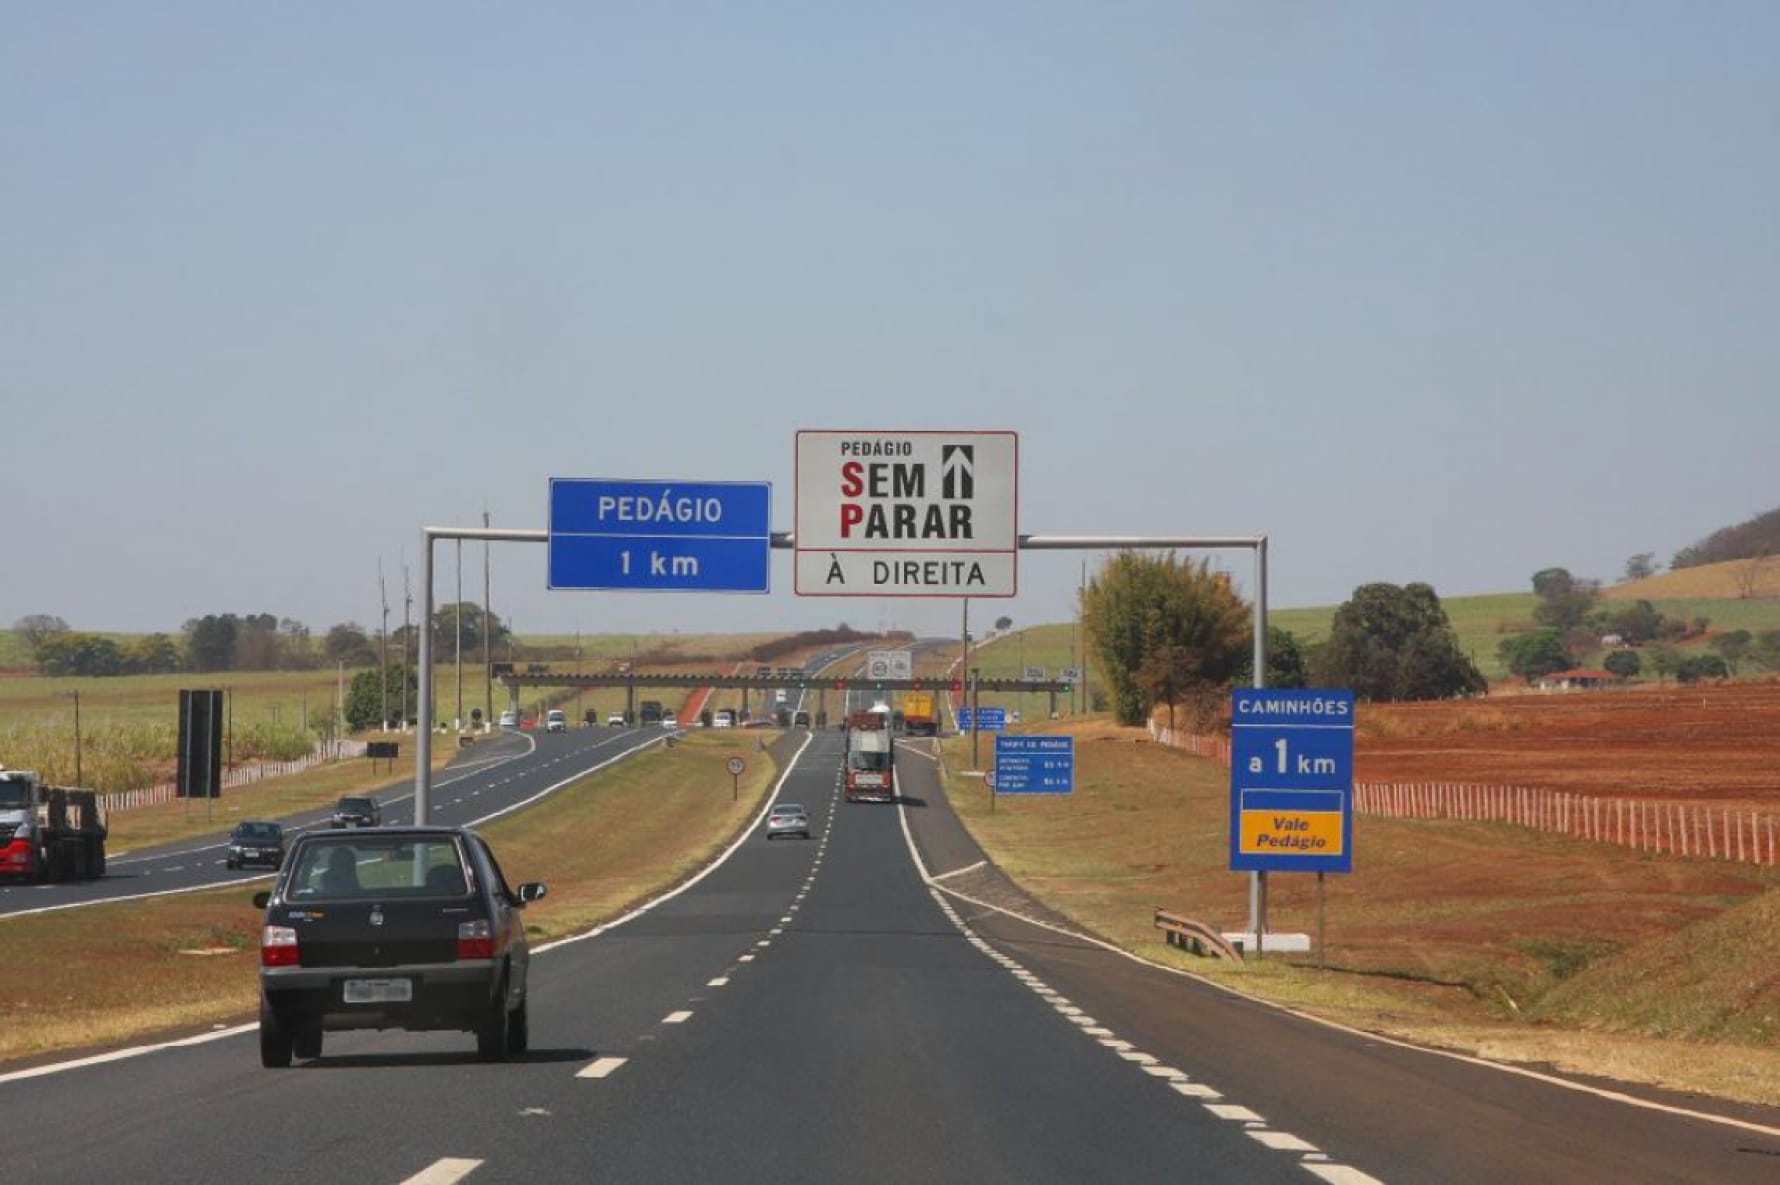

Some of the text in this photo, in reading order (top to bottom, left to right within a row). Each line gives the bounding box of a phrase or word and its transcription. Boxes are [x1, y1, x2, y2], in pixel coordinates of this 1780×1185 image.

[841, 439, 912, 457] PEDÁGIO
[841, 461, 925, 498] SEM
[598, 489, 722, 522] PEDÁGIO
[840, 503, 974, 539] PARAR
[620, 550, 699, 576] 1 km
[826, 552, 986, 585] À DIREITA
[1249, 738, 1336, 773] a 1 km
[1273, 817, 1310, 831] Vale
[1256, 833, 1326, 850] Pedágio
